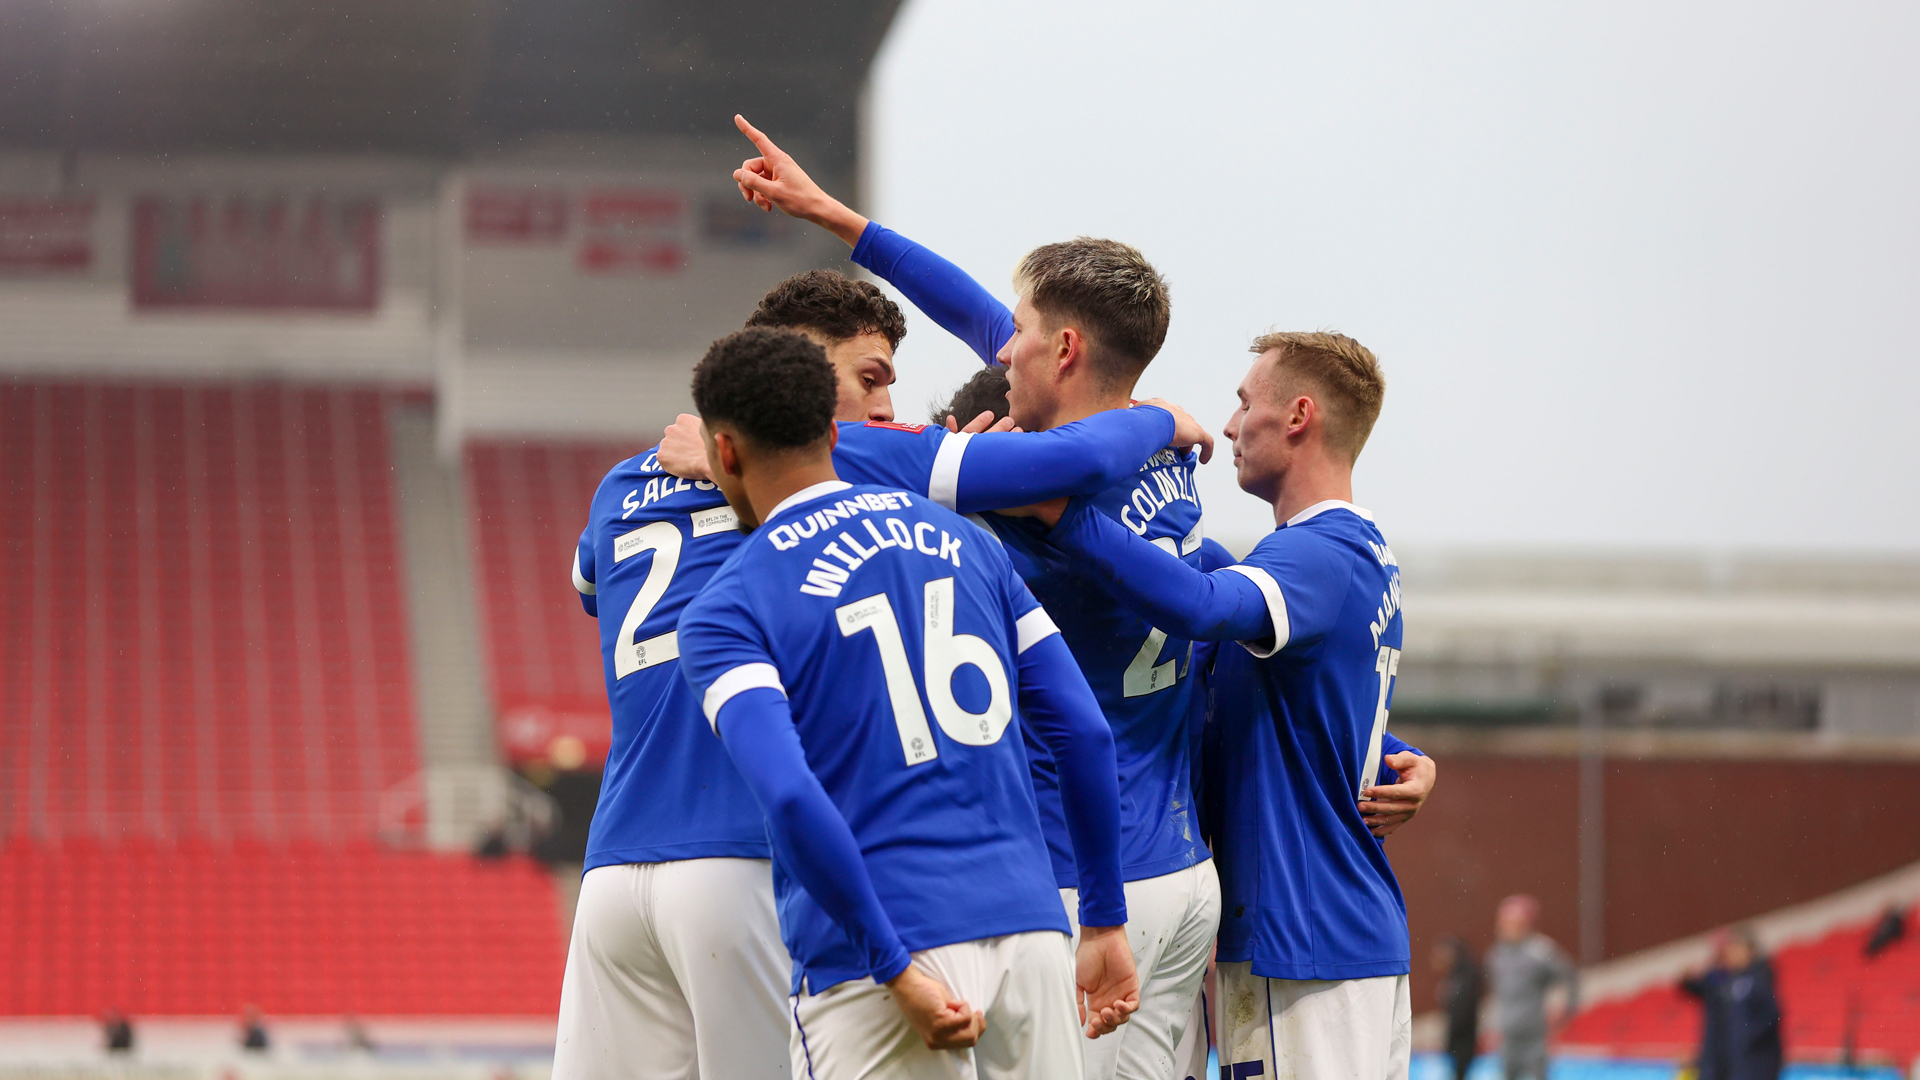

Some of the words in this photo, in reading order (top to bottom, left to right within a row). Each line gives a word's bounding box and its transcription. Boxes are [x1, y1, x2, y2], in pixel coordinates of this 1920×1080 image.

[768, 491, 913, 551] QUINNBET
[800, 517, 962, 598] WILLOCK
[835, 576, 1012, 767] 16
